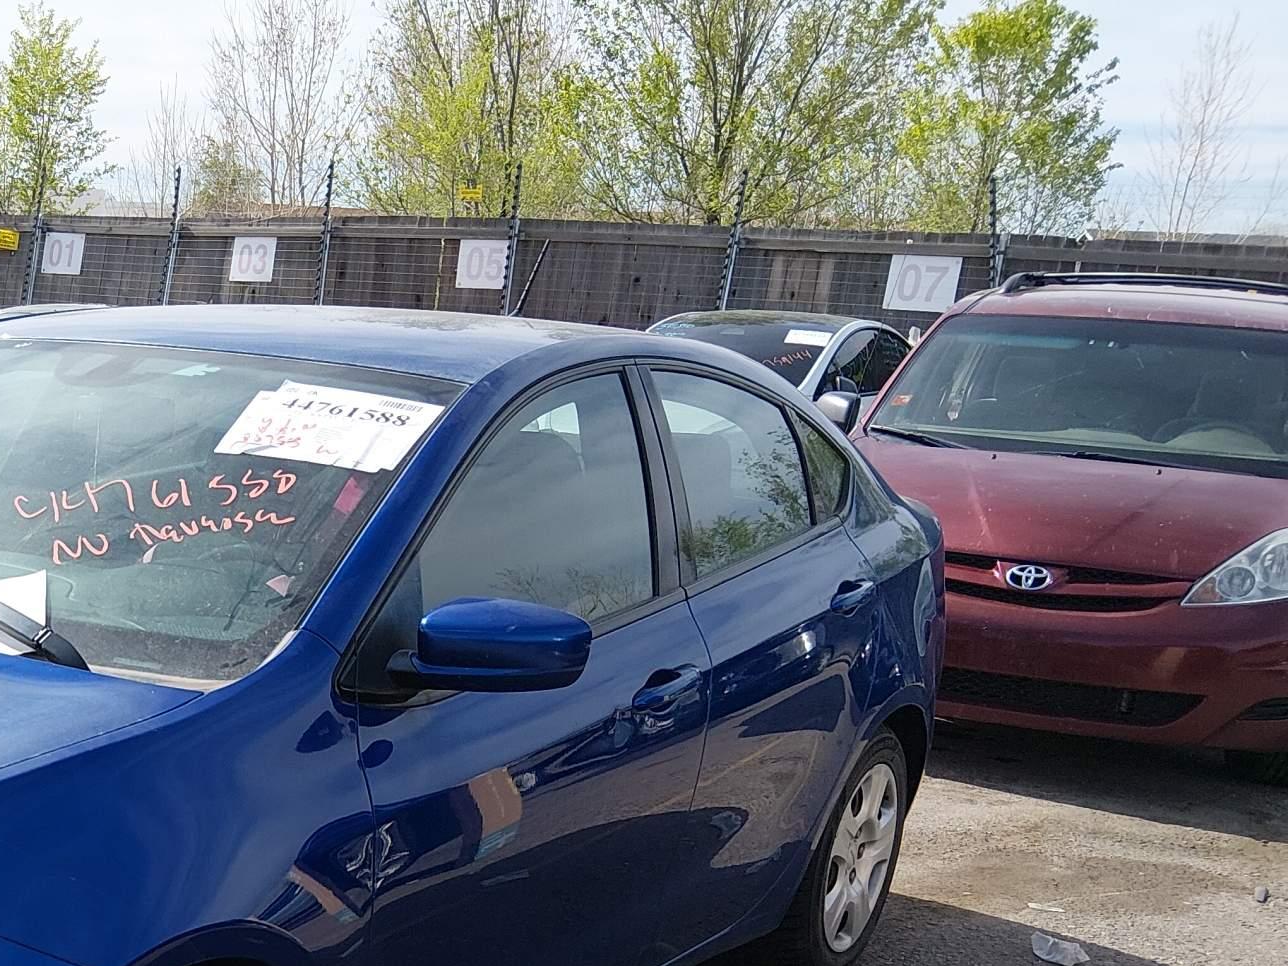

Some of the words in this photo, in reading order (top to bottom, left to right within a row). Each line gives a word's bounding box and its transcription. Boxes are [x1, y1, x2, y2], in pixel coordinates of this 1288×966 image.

[48, 240, 75, 268] 01
[237, 243, 269, 275] 03
[466, 245, 505, 281] 05
[897, 263, 950, 302] 07
[282, 398, 412, 427] 44761588
